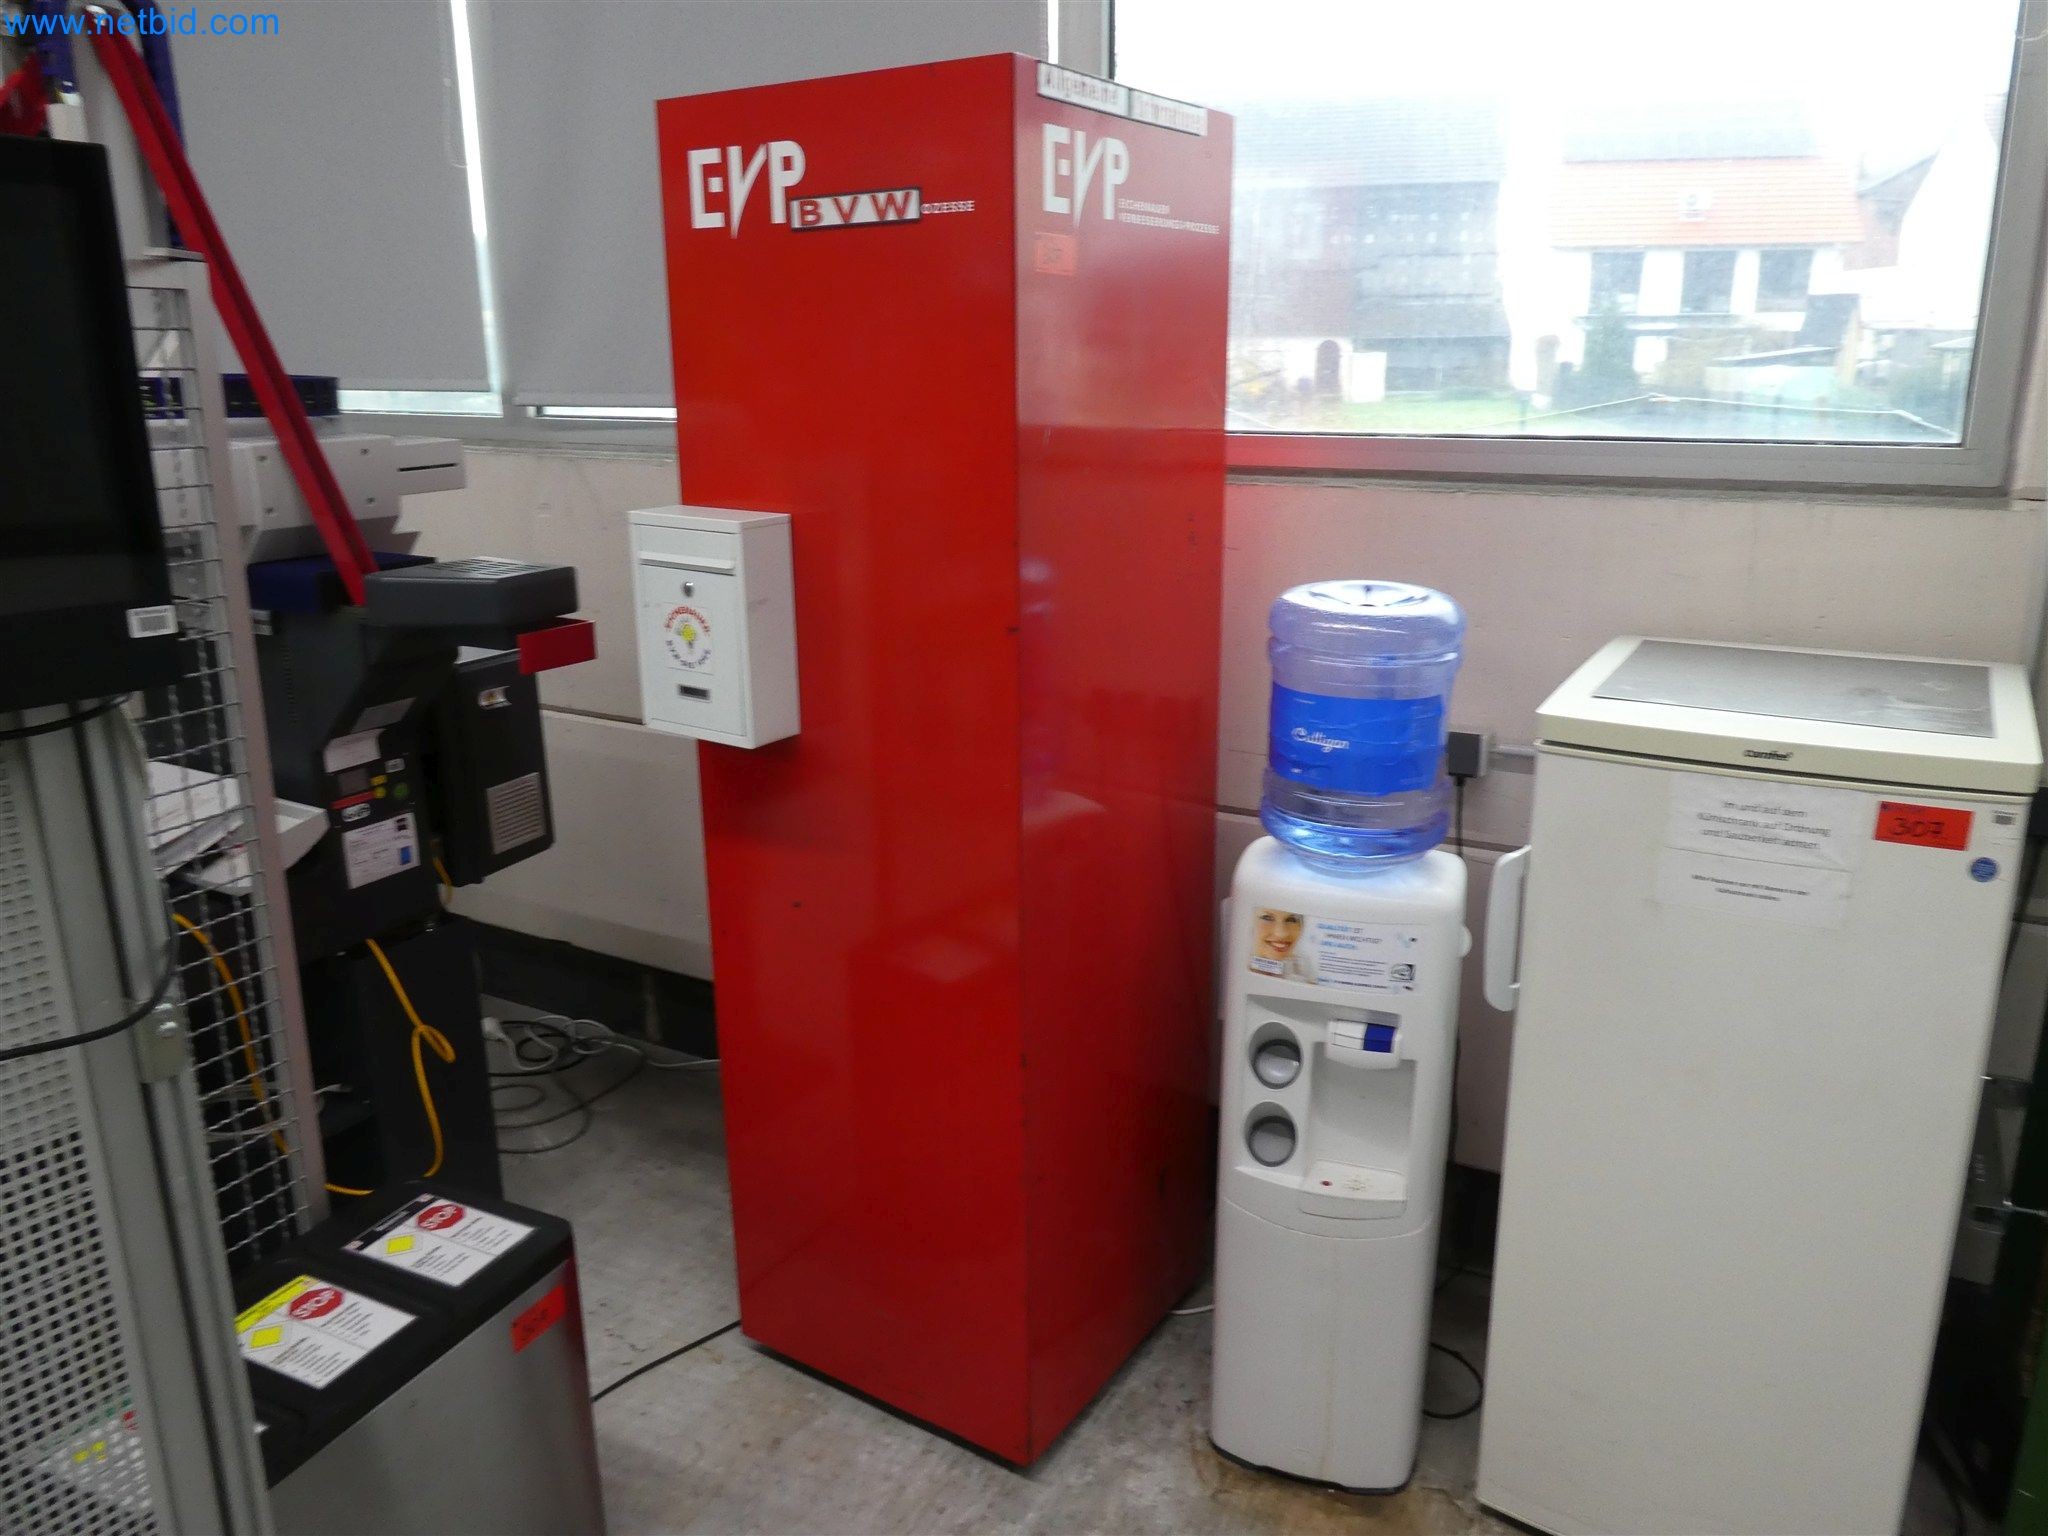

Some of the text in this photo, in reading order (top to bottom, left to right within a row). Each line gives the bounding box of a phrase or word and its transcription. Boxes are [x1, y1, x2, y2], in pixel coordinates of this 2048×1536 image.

[687, 140, 806, 239] EVP
[1042, 123, 1130, 228] EVP
[419, 1205, 457, 1230] STOP
[291, 1290, 335, 1318] STOP
